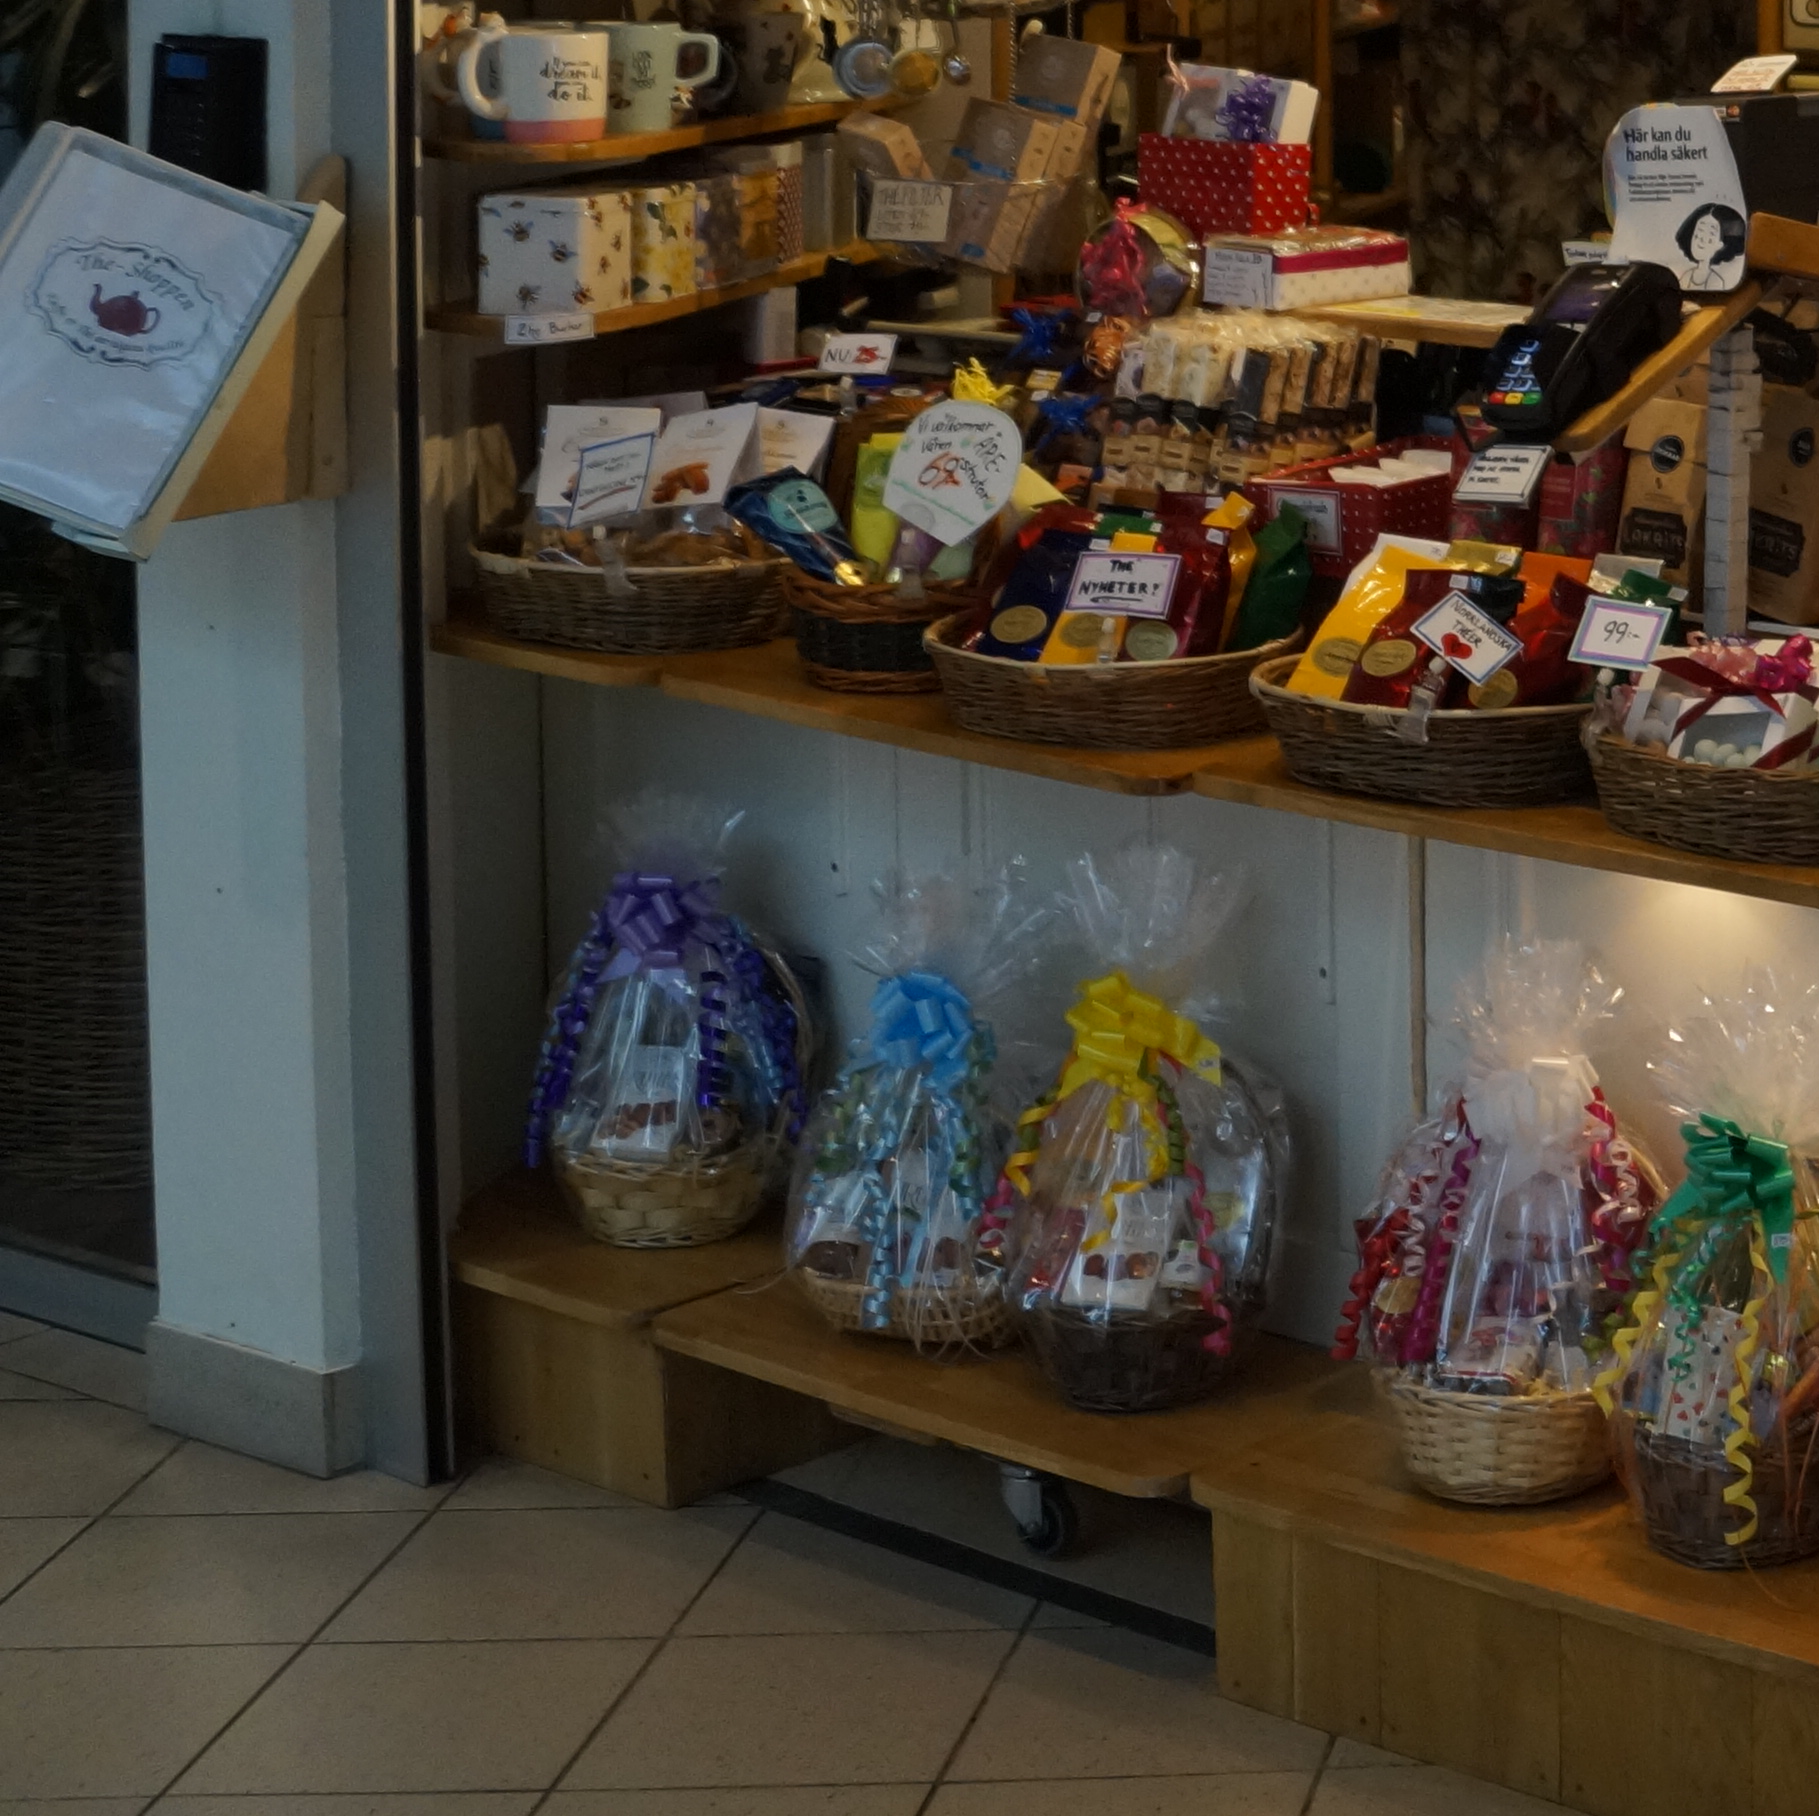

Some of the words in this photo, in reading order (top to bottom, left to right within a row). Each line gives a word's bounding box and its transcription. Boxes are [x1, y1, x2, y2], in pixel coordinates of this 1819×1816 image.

[1624, 125, 1649, 144] Här
[1651, 128, 1674, 144] kan
[1675, 127, 1692, 144] du
[1625, 145, 1669, 163] handla
[1671, 145, 1709, 162] säkert
[1449, 600, 1513, 652] NORRLANDSKA
[1603, 619, 1642, 643] 99:-
